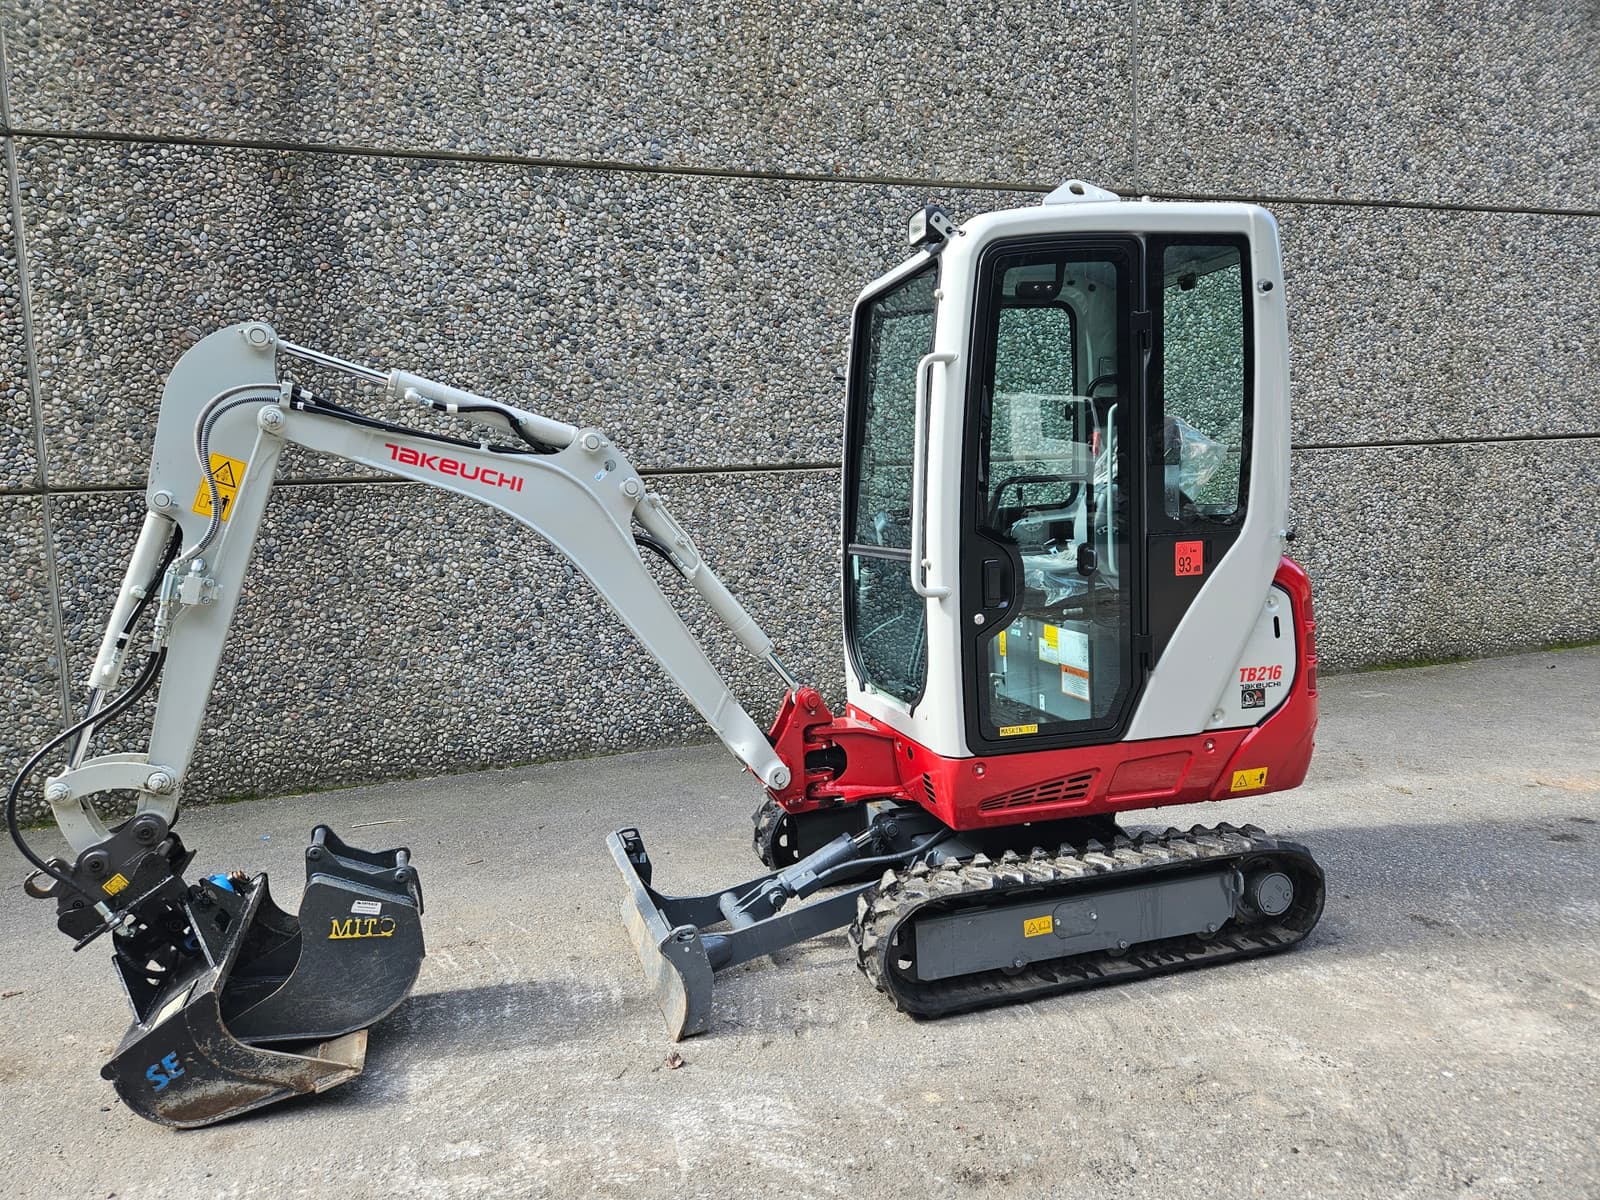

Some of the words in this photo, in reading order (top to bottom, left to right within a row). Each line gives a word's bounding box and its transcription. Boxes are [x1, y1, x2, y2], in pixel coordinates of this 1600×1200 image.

[1178, 556, 1191, 573] 93
[1240, 664, 1283, 683] TB216
[146, 1050, 185, 1092] SE
